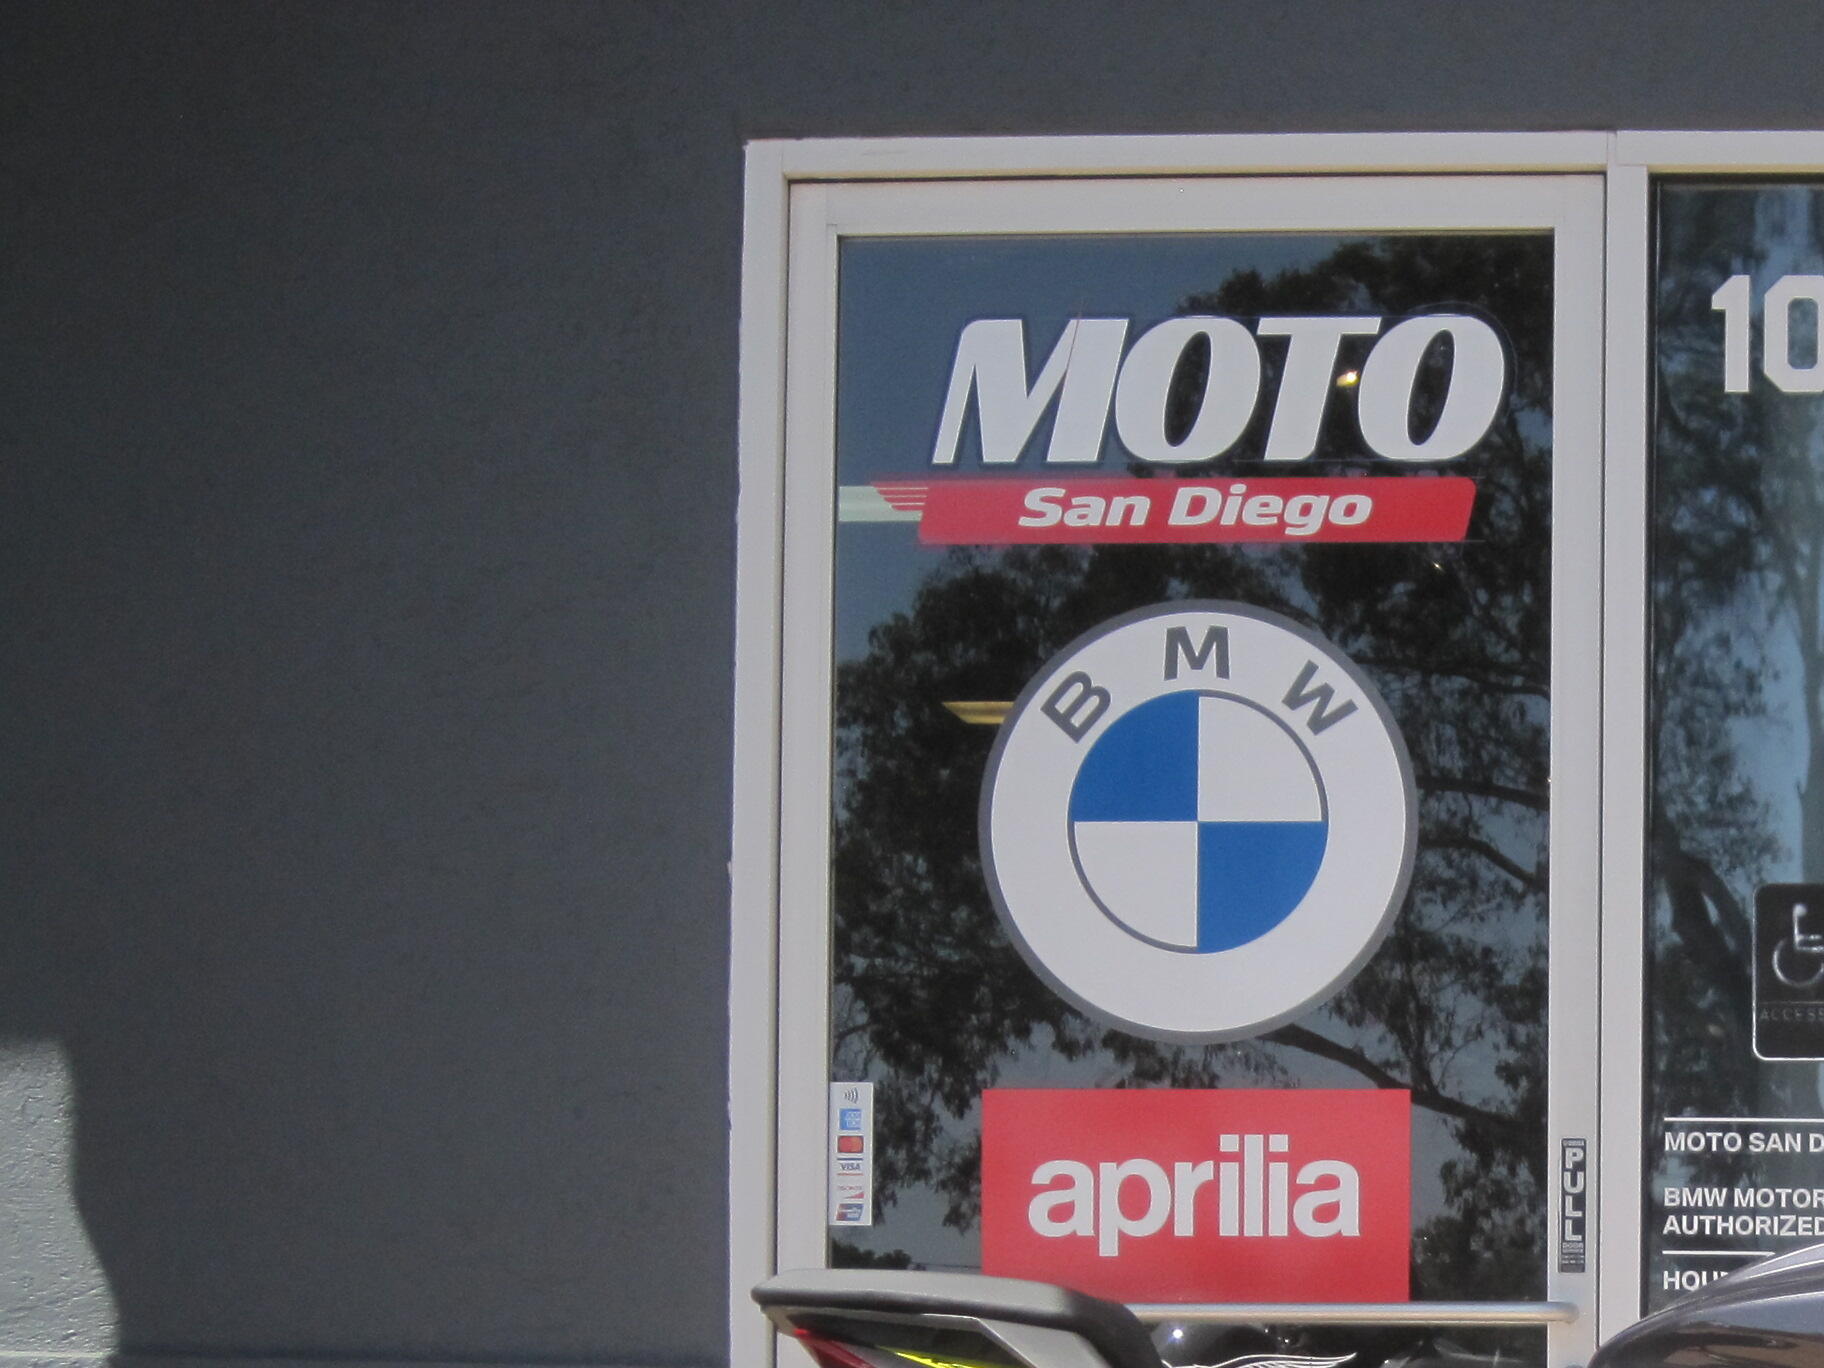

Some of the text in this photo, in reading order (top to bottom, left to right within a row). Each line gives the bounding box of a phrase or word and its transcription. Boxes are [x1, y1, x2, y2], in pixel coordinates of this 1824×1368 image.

[931, 313, 1505, 464] MOTO
[1018, 483, 1373, 536] San Diego
[1041, 626, 1358, 744] BMW
[840, 1162, 861, 1171] VISA
[1664, 1132, 1741, 1153] MOTO
[1749, 1133, 1801, 1153] SAN
[1028, 1134, 1361, 1257] aprilia
[1563, 1147, 1584, 1241] PULL
[1663, 1188, 1727, 1207] BMW
